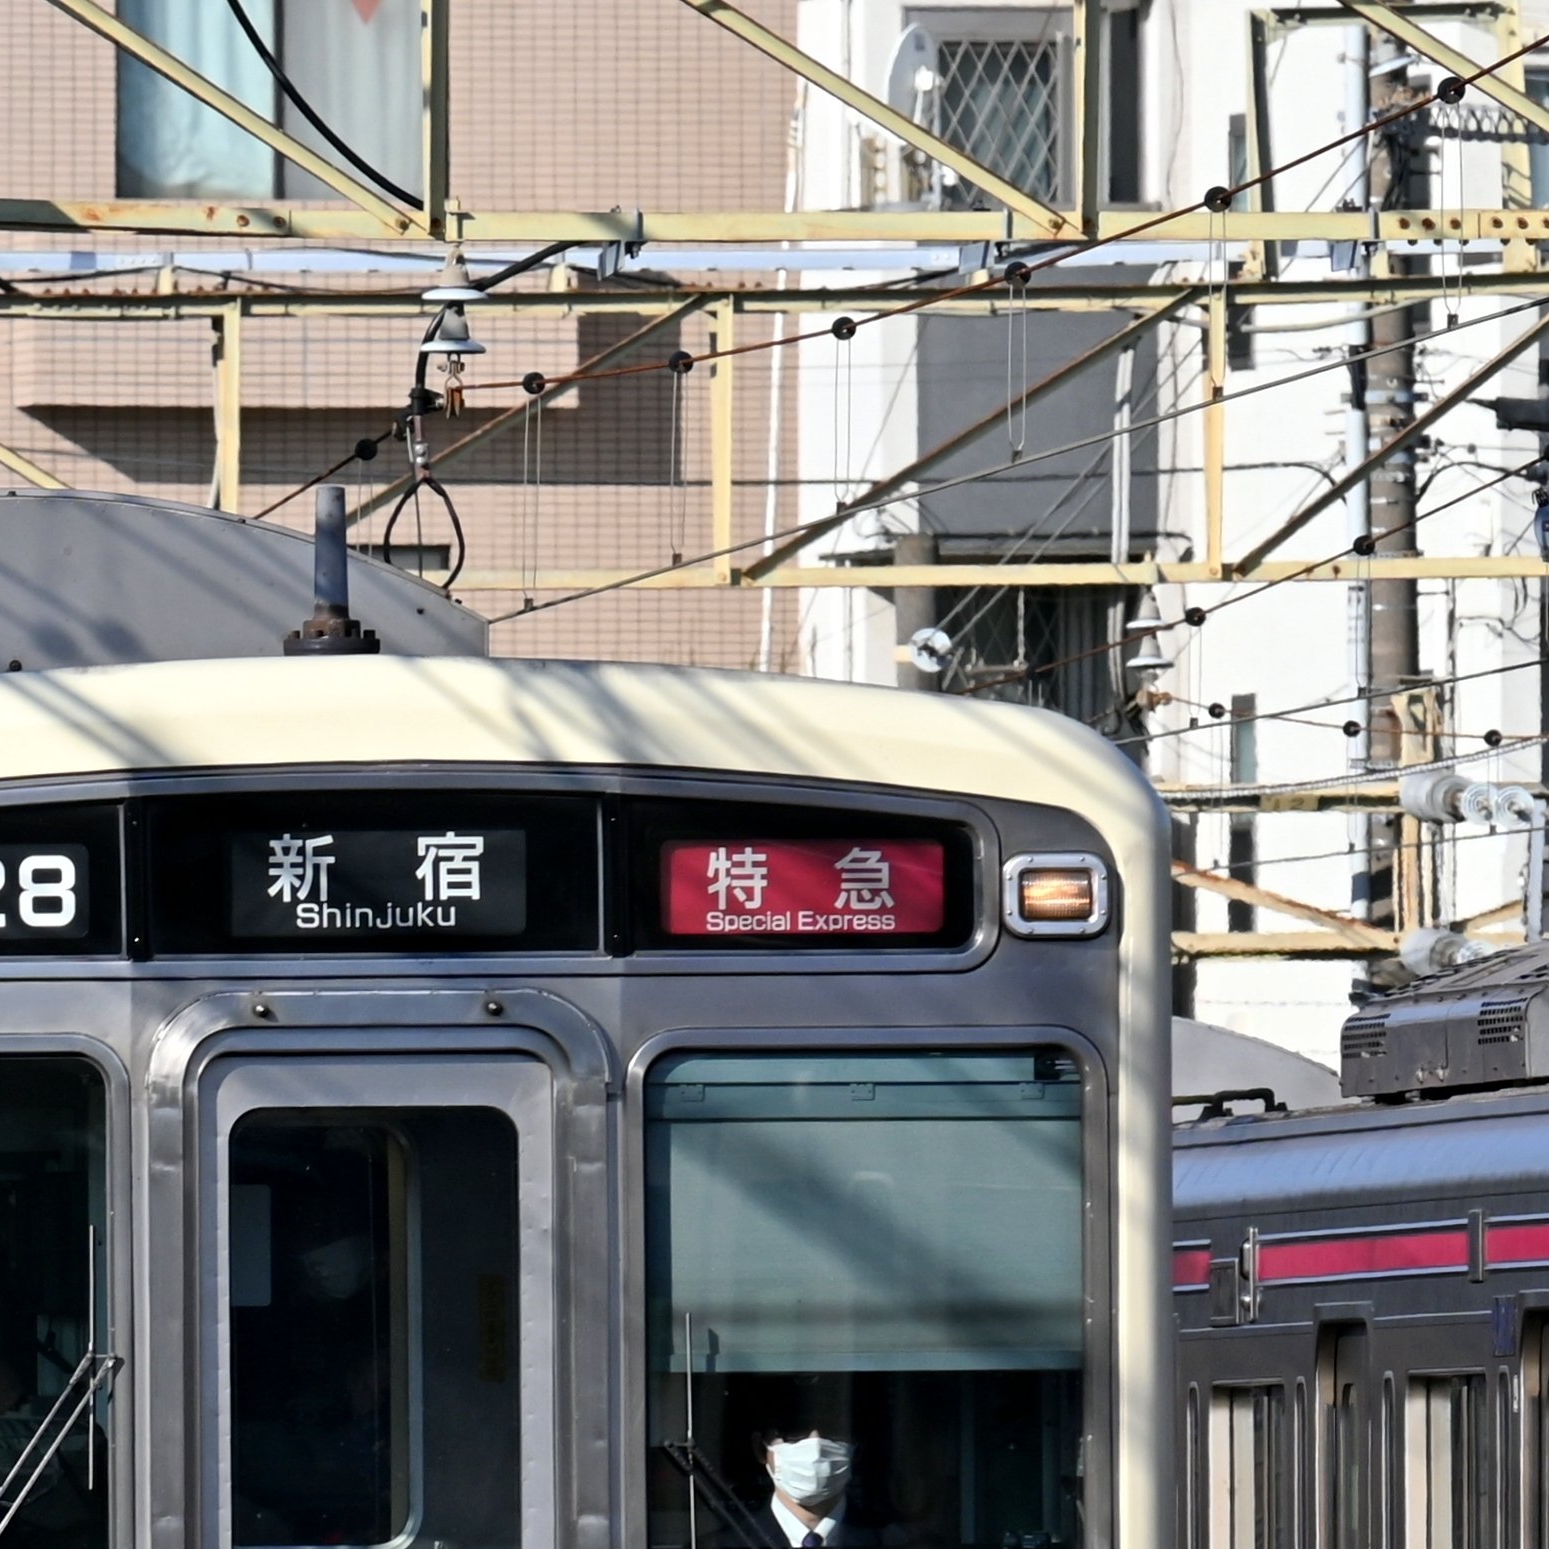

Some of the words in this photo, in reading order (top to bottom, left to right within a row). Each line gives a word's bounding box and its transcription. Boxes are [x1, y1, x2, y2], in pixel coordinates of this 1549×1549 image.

[267, 831, 485, 903] 新宿
[706, 847, 895, 911] 特急
[296, 902, 457, 929] Shinjuku
[706, 911, 791, 932] Special
[797, 911, 896, 932] Express
